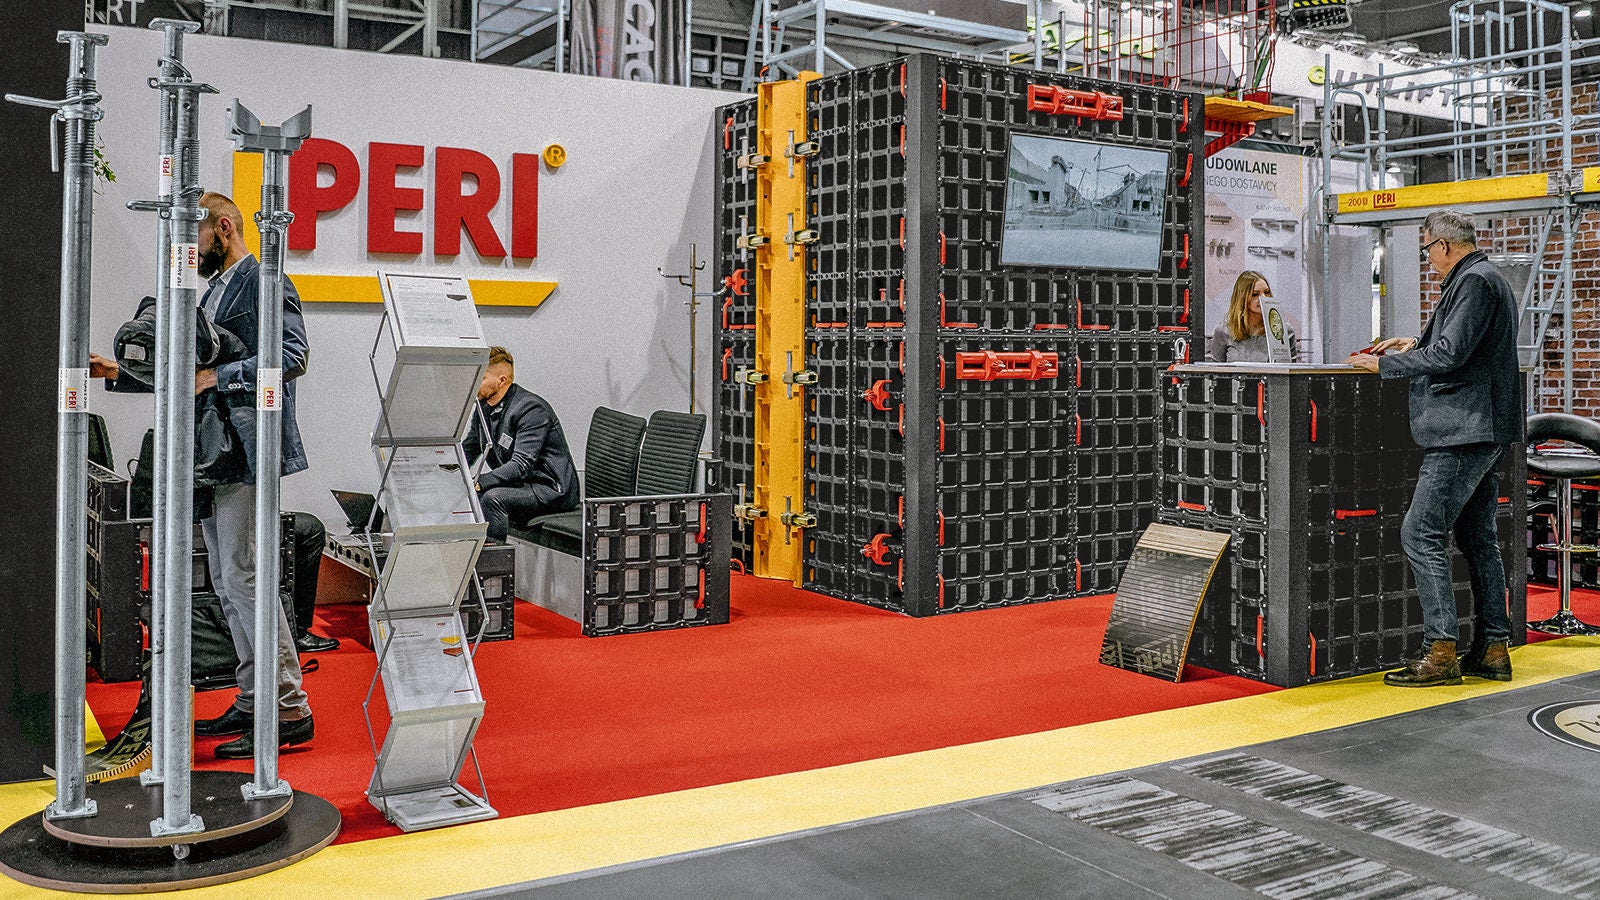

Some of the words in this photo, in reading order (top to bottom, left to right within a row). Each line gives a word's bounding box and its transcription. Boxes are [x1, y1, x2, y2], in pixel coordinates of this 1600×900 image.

[162, 157, 170, 173] PERI
[1206, 157, 1278, 176] UDOWLANE
[1230, 177, 1278, 192] DOSTAWCY
[287, 137, 540, 258] PERI
[1376, 192, 1396, 204] PERI
[188, 246, 196, 265] PERI
[68, 391, 77, 409] PERI
[266, 390, 274, 408] PERI
